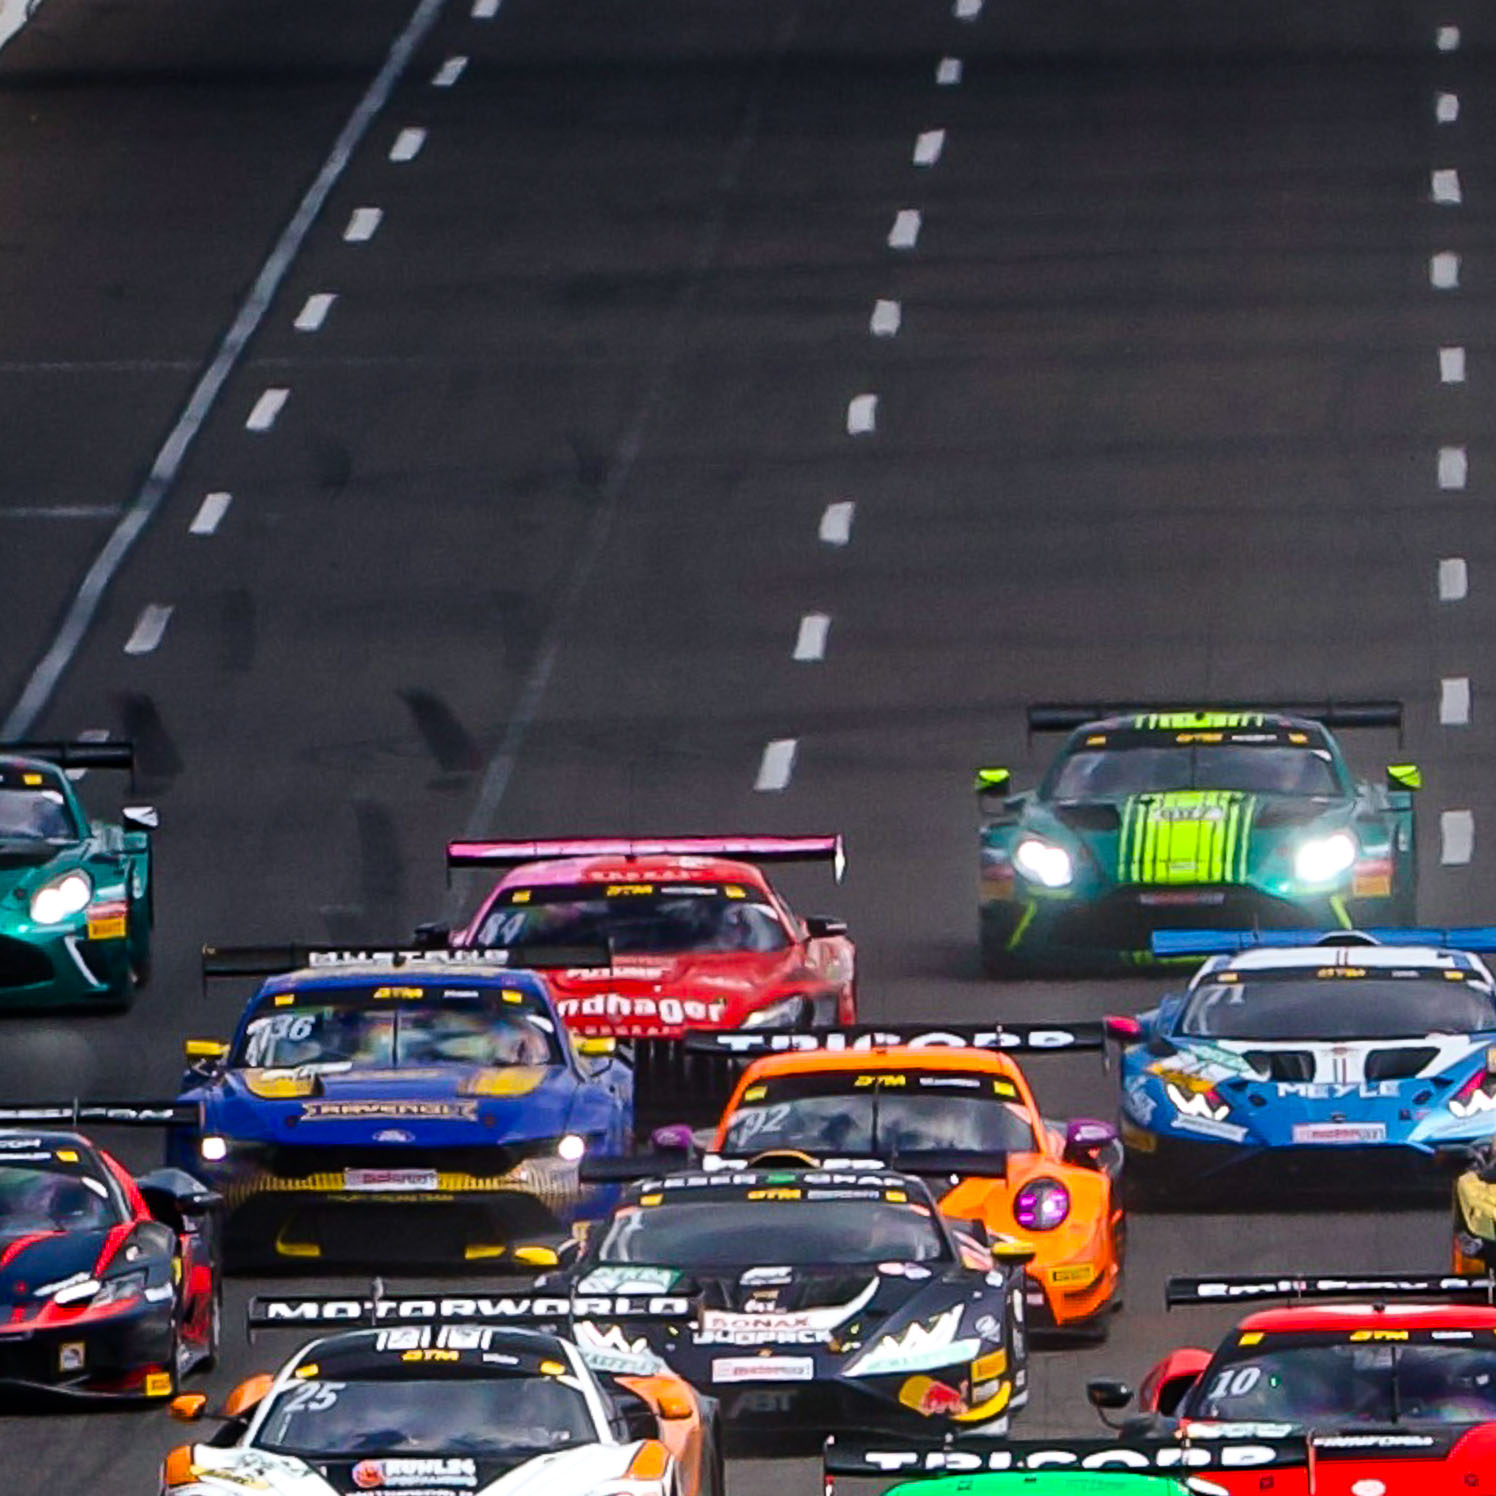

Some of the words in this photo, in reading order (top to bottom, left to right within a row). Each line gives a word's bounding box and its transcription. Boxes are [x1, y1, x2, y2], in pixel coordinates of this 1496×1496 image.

[558, 992, 726, 1024] ndhager
[1277, 1081, 1400, 1099] MEYLE
[1198, 1280, 1307, 1296] Emil
[267, 1297, 688, 1319] MOTORWORLD
[1209, 1367, 1261, 1398] 10
[285, 1383, 345, 1411] 25
